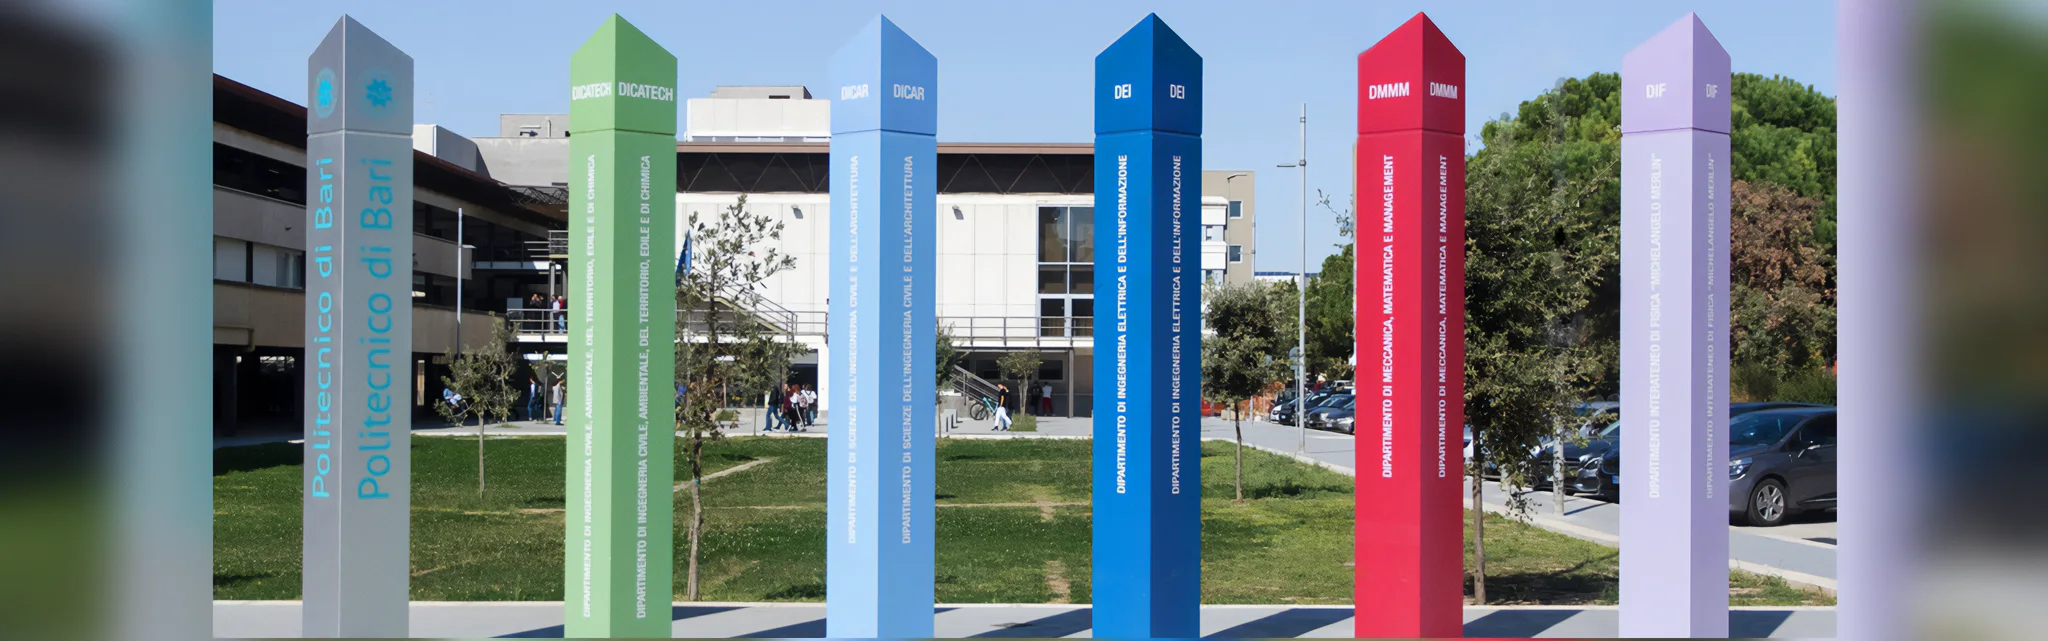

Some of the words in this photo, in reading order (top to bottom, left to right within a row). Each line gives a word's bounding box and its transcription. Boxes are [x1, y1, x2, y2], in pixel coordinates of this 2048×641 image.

[571, 82, 612, 101] DICATECH
[618, 81, 674, 102] DICATECH
[841, 83, 869, 101] DICAR
[893, 83, 925, 101] DICAR
[1114, 83, 1132, 100] DEI
[1169, 83, 1185, 100] DEI
[1368, 81, 1410, 100] DMMM
[1429, 81, 1458, 100] DMMM
[1645, 82, 1667, 99] DIF
[315, 158, 332, 229] Bari
[360, 158, 393, 230] Bari
[587, 155, 596, 200] CHIMICA
[640, 156, 651, 200] CHIMICA
[1383, 155, 1394, 232] MANAGEMENT
[1439, 155, 1448, 232] MANAGEMENT
[586, 202, 595, 213] DI
[639, 203, 650, 214] DI
[848, 156, 859, 262] DELL'ARCHITETTURA
[903, 156, 914, 262] DELL'ARCHITETTURA
[1117, 155, 1128, 263] DELL'INFORMAZIONE
[1172, 156, 1182, 263] DELL'INFORMAZIONE
[315, 246, 332, 278] di
[360, 246, 392, 279] di
[586, 226, 595, 256] EDILE
[639, 227, 650, 256] EDILE
[585, 259, 595, 323] TERRITORIO,
[638, 260, 651, 323] TERRITORIO,
[849, 276, 858, 307] CIVILE
[903, 276, 913, 307] CIVILE
[1117, 275, 1127, 332] ELETTRICA
[1172, 276, 1181, 332] ELETTRICA
[1382, 245, 1394, 314] MATEMATICA
[1438, 246, 1447, 314] MATEMATICA
[585, 326, 594, 346] DEL
[638, 326, 649, 346] DEL
[1649, 293, 1661, 327] FISICA
[1649, 331, 1662, 341] DI
[848, 310, 858, 402] DELL'INGEGNERIA
[902, 310, 913, 402] DELL'INGEGNERIA
[1116, 334, 1127, 398] INGEGNERIA
[1171, 336, 1181, 399] INGEGNERIA
[1382, 317, 1395, 382] MECCANICA,
[1438, 317, 1447, 382] MECCANICA,
[312, 292, 331, 498] Politecnico
[358, 292, 392, 499] Politecnico
[584, 349, 594, 418] AMBIENTALE,
[638, 350, 650, 419] AMBIENTALE,
[1116, 402, 1127, 412] DI
[1171, 403, 1181, 413] DI
[1382, 386, 1393, 396] DI
[1438, 386, 1447, 396] DI
[1649, 344, 1661, 417] INTERATENEO
[584, 421, 594, 456] CIVILE,
[637, 421, 649, 456] CIVILE,
[848, 405, 857, 449] SCIENZE
[902, 405, 912, 449] SCIENZE
[1116, 415, 1127, 494] DIPARTIMENTO
[1171, 416, 1181, 494] DIPARTIMENTO
[1381, 399, 1393, 478] DIPARTIMENTO
[1438, 400, 1446, 477] DIPARTIMENTO
[847, 451, 857, 463] DI
[901, 452, 912, 463] DI
[1648, 420, 1661, 498] DIPARTIMENTO
[583, 459, 592, 523] INGEGNERIA
[637, 459, 648, 524] INGEGNERIA
[847, 466, 857, 544] DIPARTIMENTO
[901, 466, 912, 543] DIPARTIMENTO
[583, 525, 592, 536] DI
[636, 526, 647, 537] DI
[583, 540, 592, 617] DIPARTIMENTO
[636, 540, 647, 618] DIPARTIMENTO
